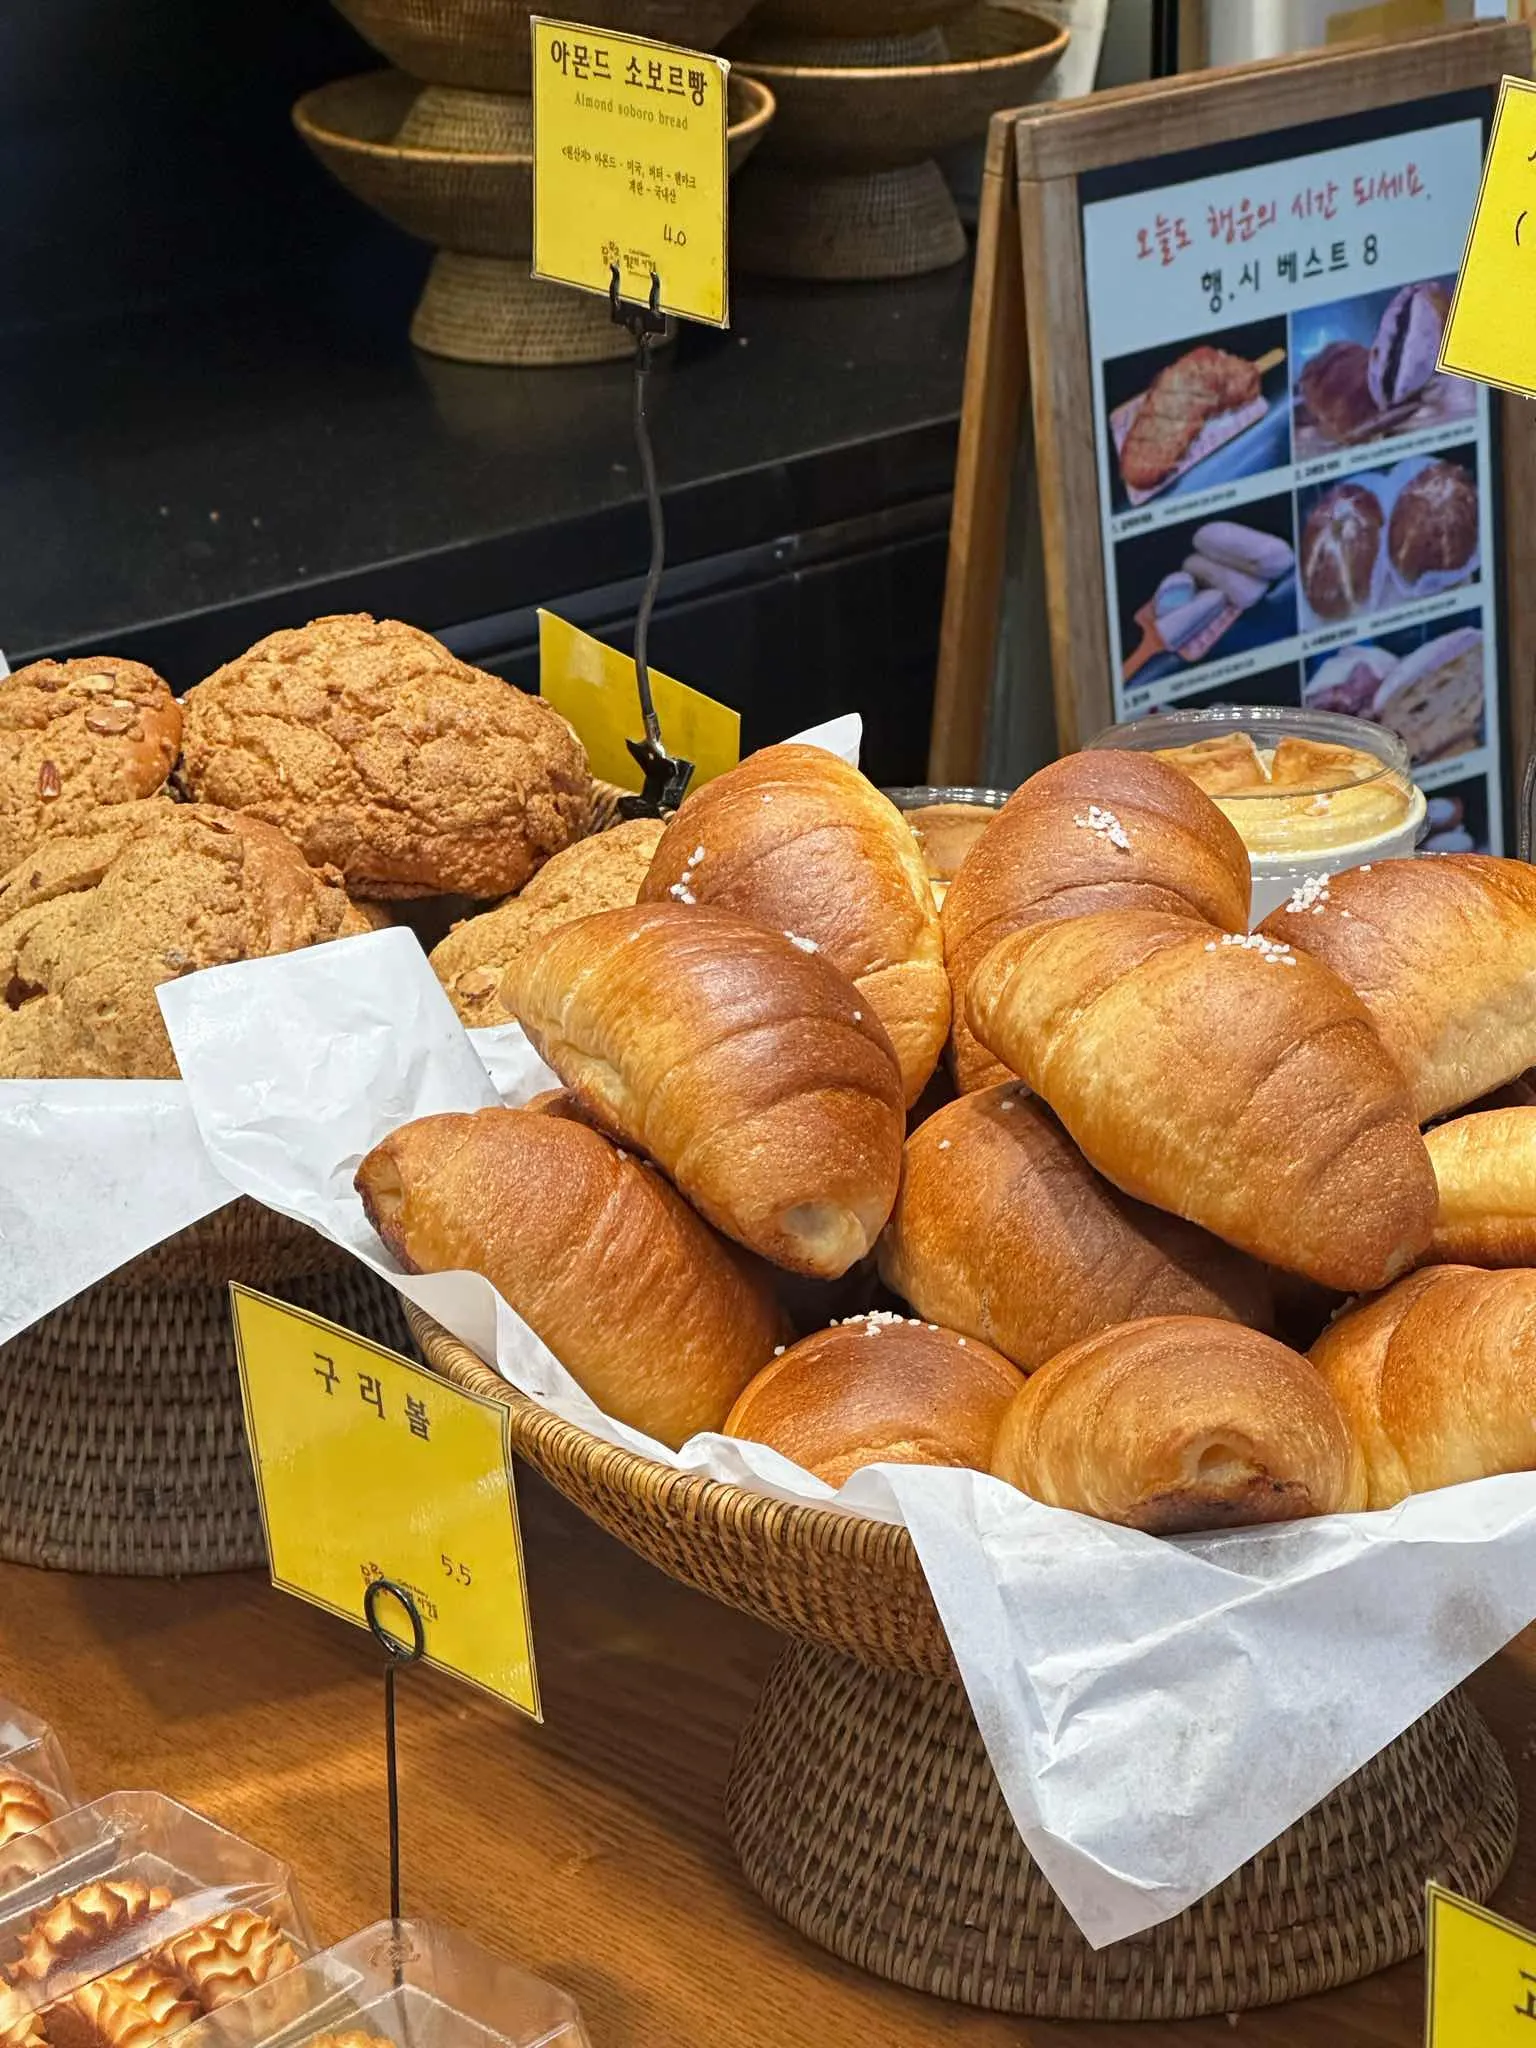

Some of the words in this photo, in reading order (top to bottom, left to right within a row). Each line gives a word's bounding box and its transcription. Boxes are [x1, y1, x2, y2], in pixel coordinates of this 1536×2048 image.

[550, 39, 612, 80] 아몬드
[624, 55, 708, 107] 소보르빵
[574, 91, 614, 113] Almond
[618, 104, 654, 123] soboro
[659, 110, 689, 130] bread
[662, 222, 688, 248] 4.0
[1135, 216, 1194, 267] 오늘도
[1206, 197, 1278, 246] 행운의
[1290, 181, 1340, 221] 시간
[1276, 240, 1350, 285] 베스트
[1362, 233, 1380, 266] 8
[440, 1552, 473, 1587] 5.5
